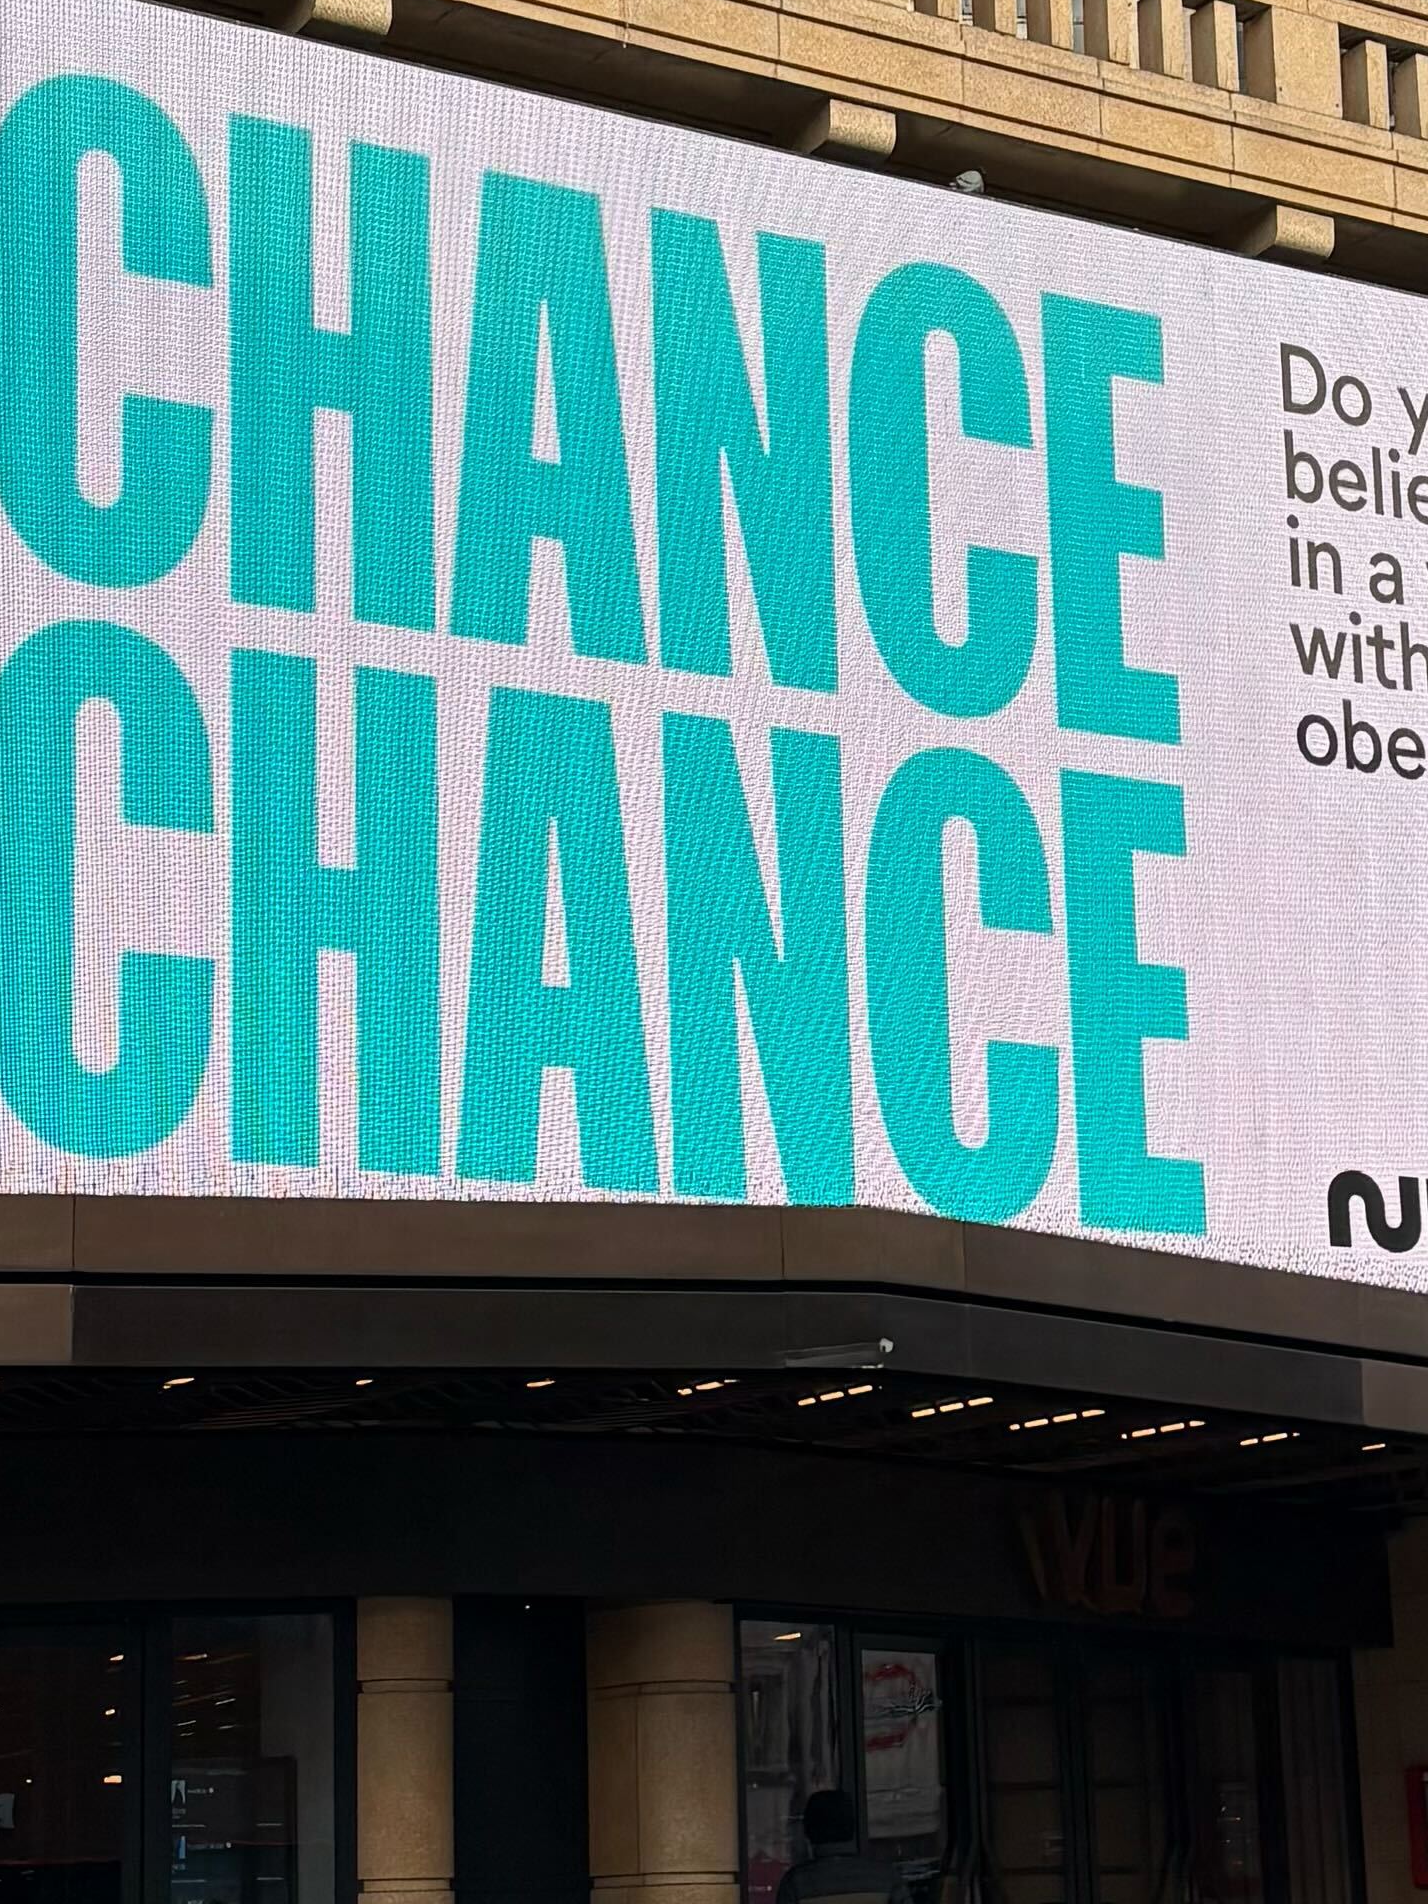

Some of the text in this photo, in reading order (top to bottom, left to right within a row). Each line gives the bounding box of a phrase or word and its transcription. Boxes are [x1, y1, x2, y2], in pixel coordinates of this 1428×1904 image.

[1279, 342, 1373, 427] Do
[1287, 515, 1343, 595] in
[1369, 552, 1404, 605] a
